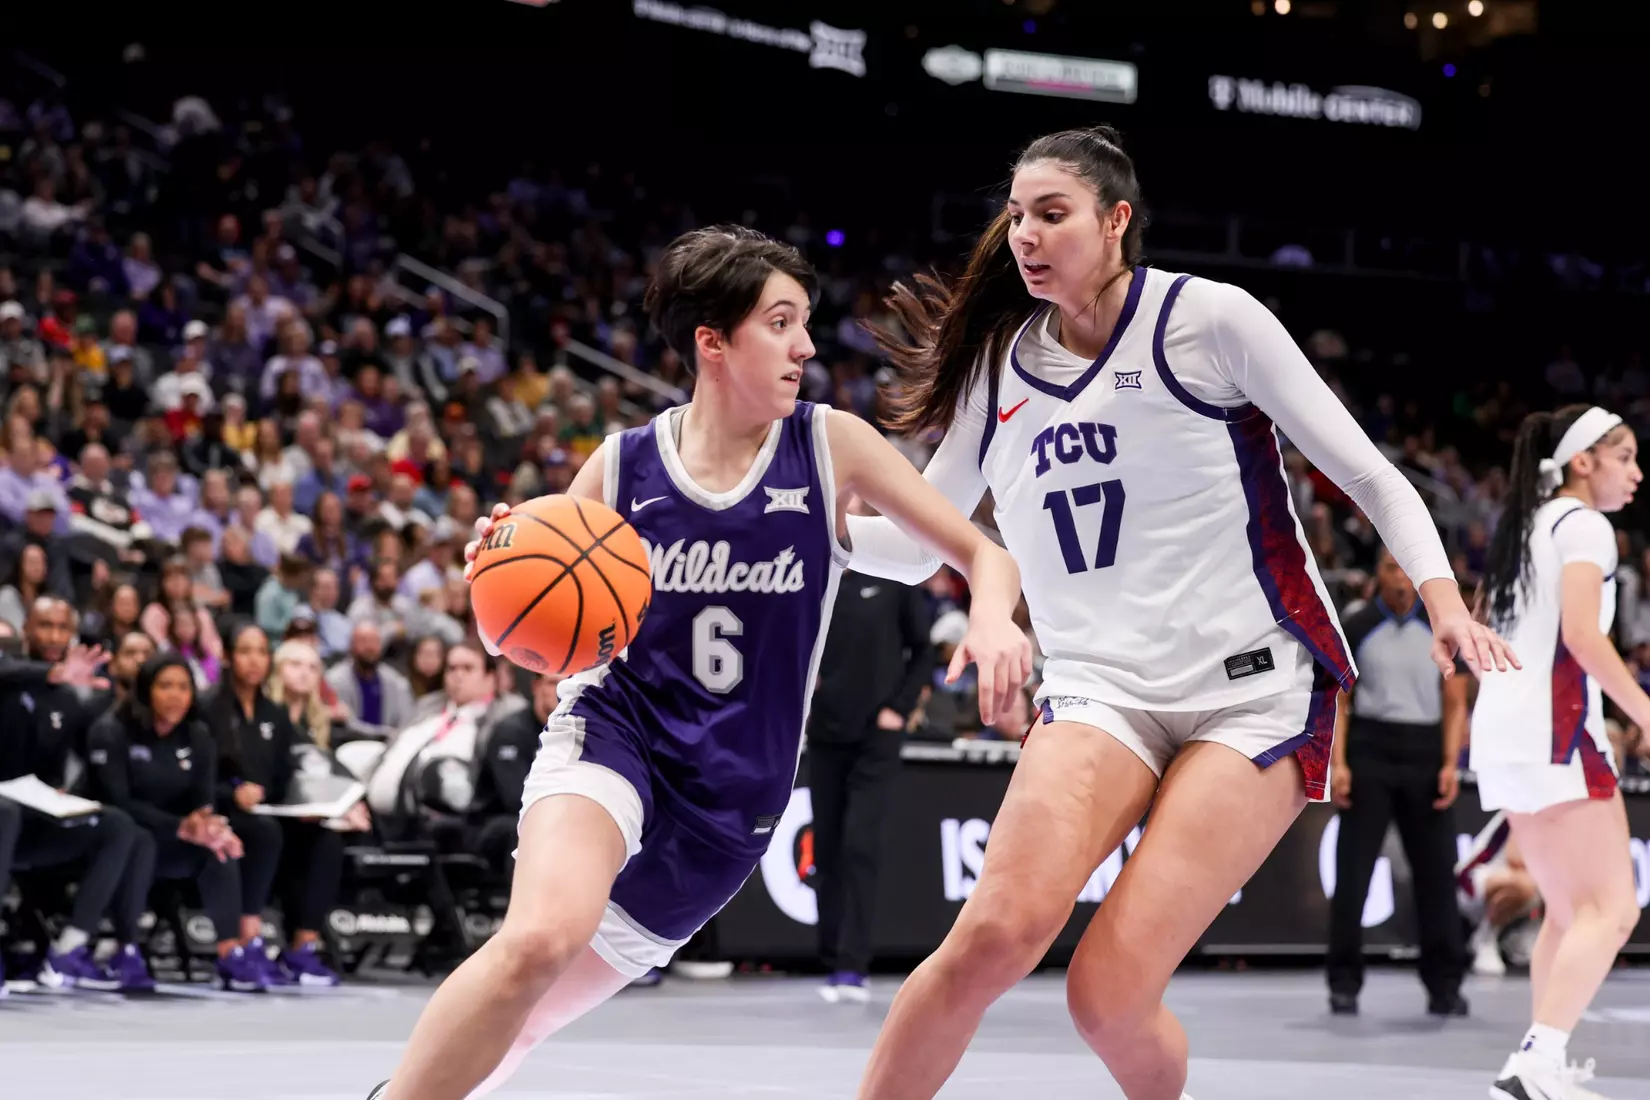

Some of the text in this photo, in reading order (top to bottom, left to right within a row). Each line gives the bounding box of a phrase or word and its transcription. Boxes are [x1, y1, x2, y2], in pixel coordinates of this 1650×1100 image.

[1030, 421, 1118, 479] TCU
[1042, 479, 1126, 575] 17
[640, 537, 805, 594] Wildcats
[692, 604, 744, 695] 6
[1256, 655, 1268, 665] XL
